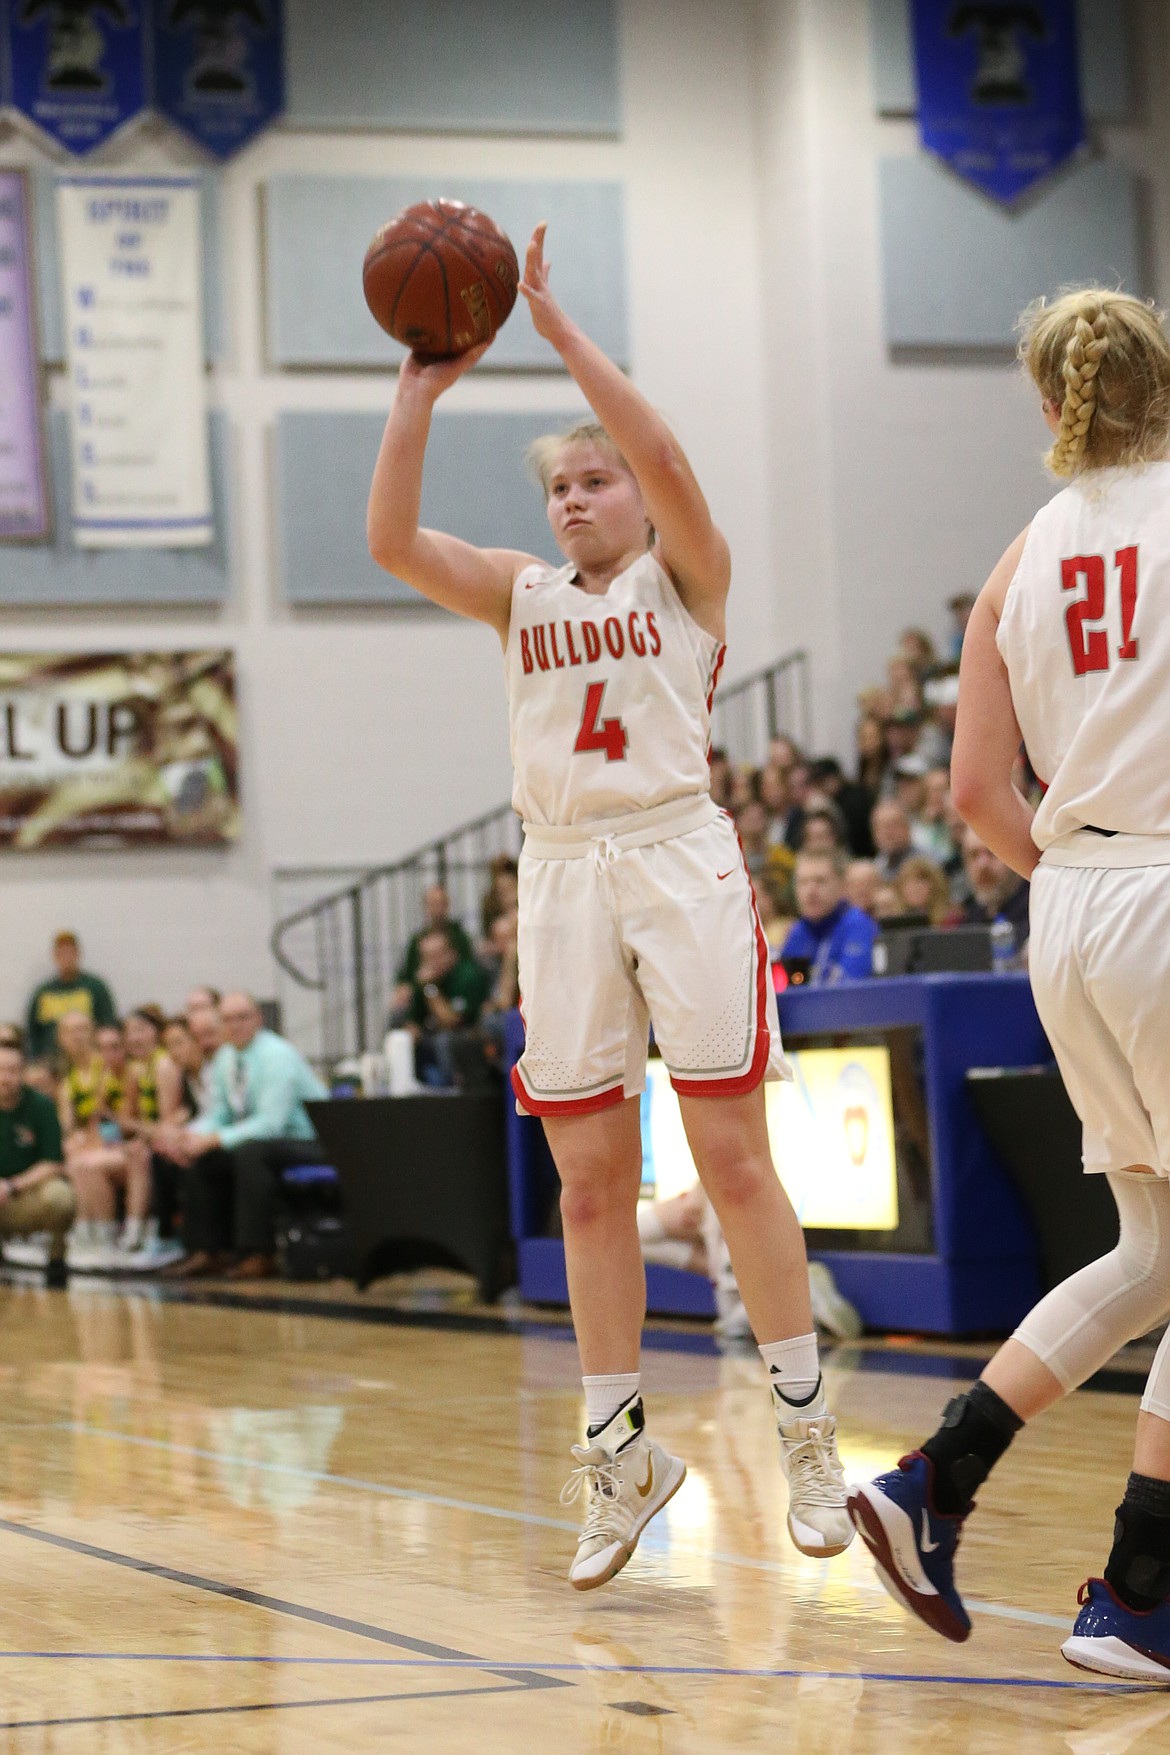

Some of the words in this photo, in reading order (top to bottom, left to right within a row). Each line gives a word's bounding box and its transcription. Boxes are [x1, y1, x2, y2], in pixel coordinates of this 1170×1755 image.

[520, 611, 662, 675] BULLDOGS
[1060, 543, 1140, 678] 21
[57, 700, 141, 759] UP
[572, 679, 630, 764] 4
